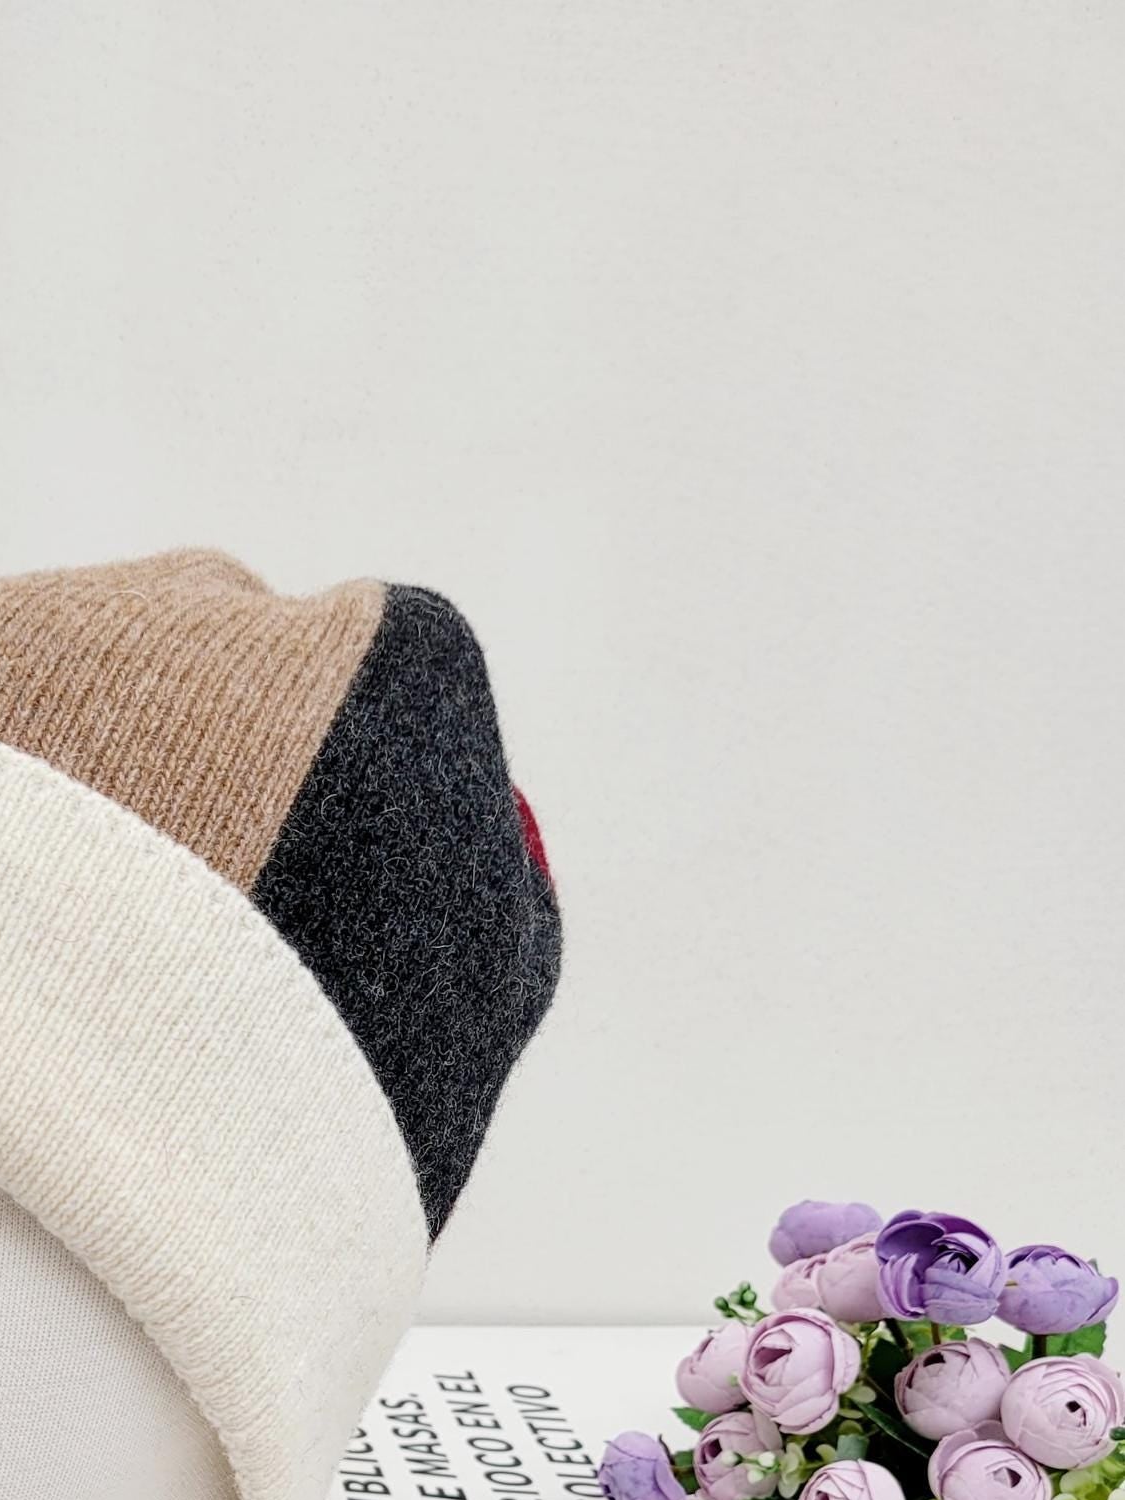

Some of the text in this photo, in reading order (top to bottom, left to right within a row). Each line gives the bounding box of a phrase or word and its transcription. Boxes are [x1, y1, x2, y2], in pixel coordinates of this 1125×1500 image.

[433, 1371, 482, 1394] EL
[446, 1399, 502, 1430] EN
[379, 1393, 457, 1478] MASAS.
